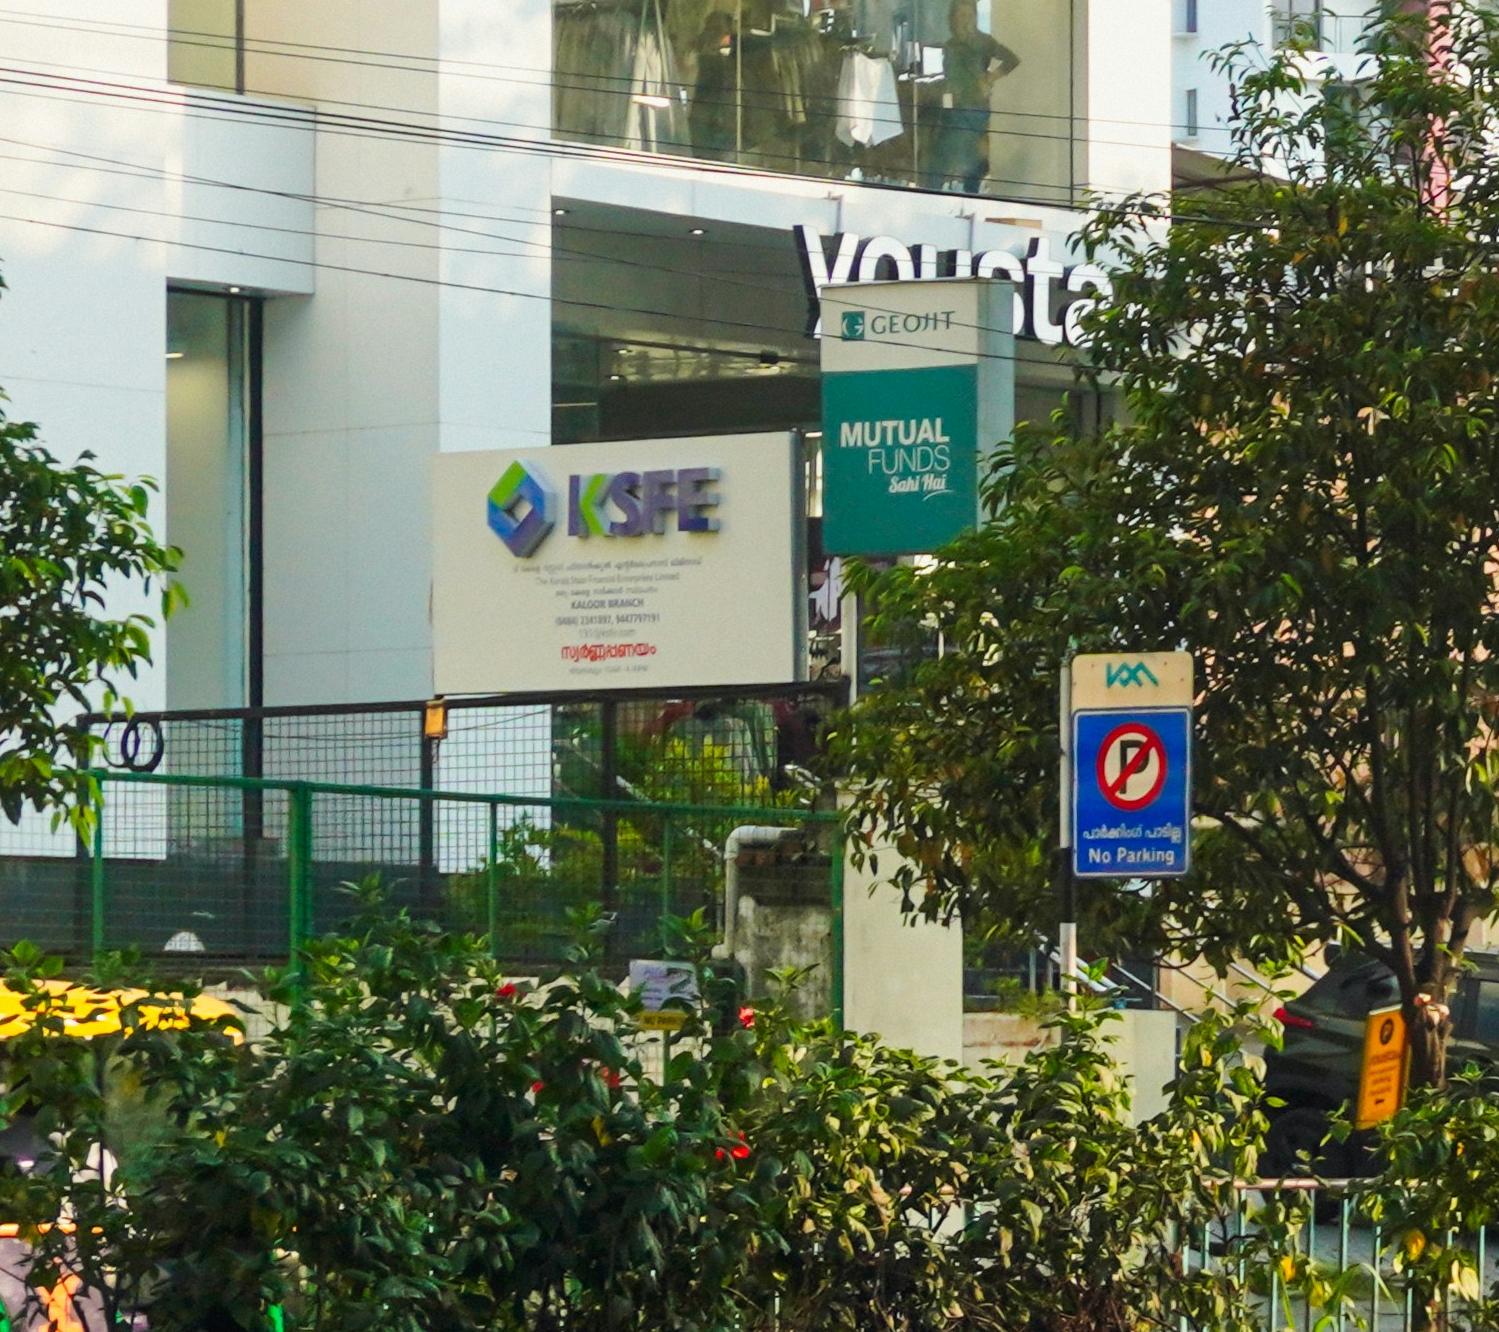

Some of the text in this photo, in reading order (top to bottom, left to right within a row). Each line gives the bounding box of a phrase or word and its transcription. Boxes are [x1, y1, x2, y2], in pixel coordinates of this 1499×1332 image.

[870, 310, 957, 335] GEOJIT
[839, 417, 951, 448] MUTUAL
[868, 445, 951, 475] FUNDS
[888, 473, 948, 494] Sahi Hai
[567, 467, 718, 537] KSFE
[1088, 846, 1176, 866] No Parking
